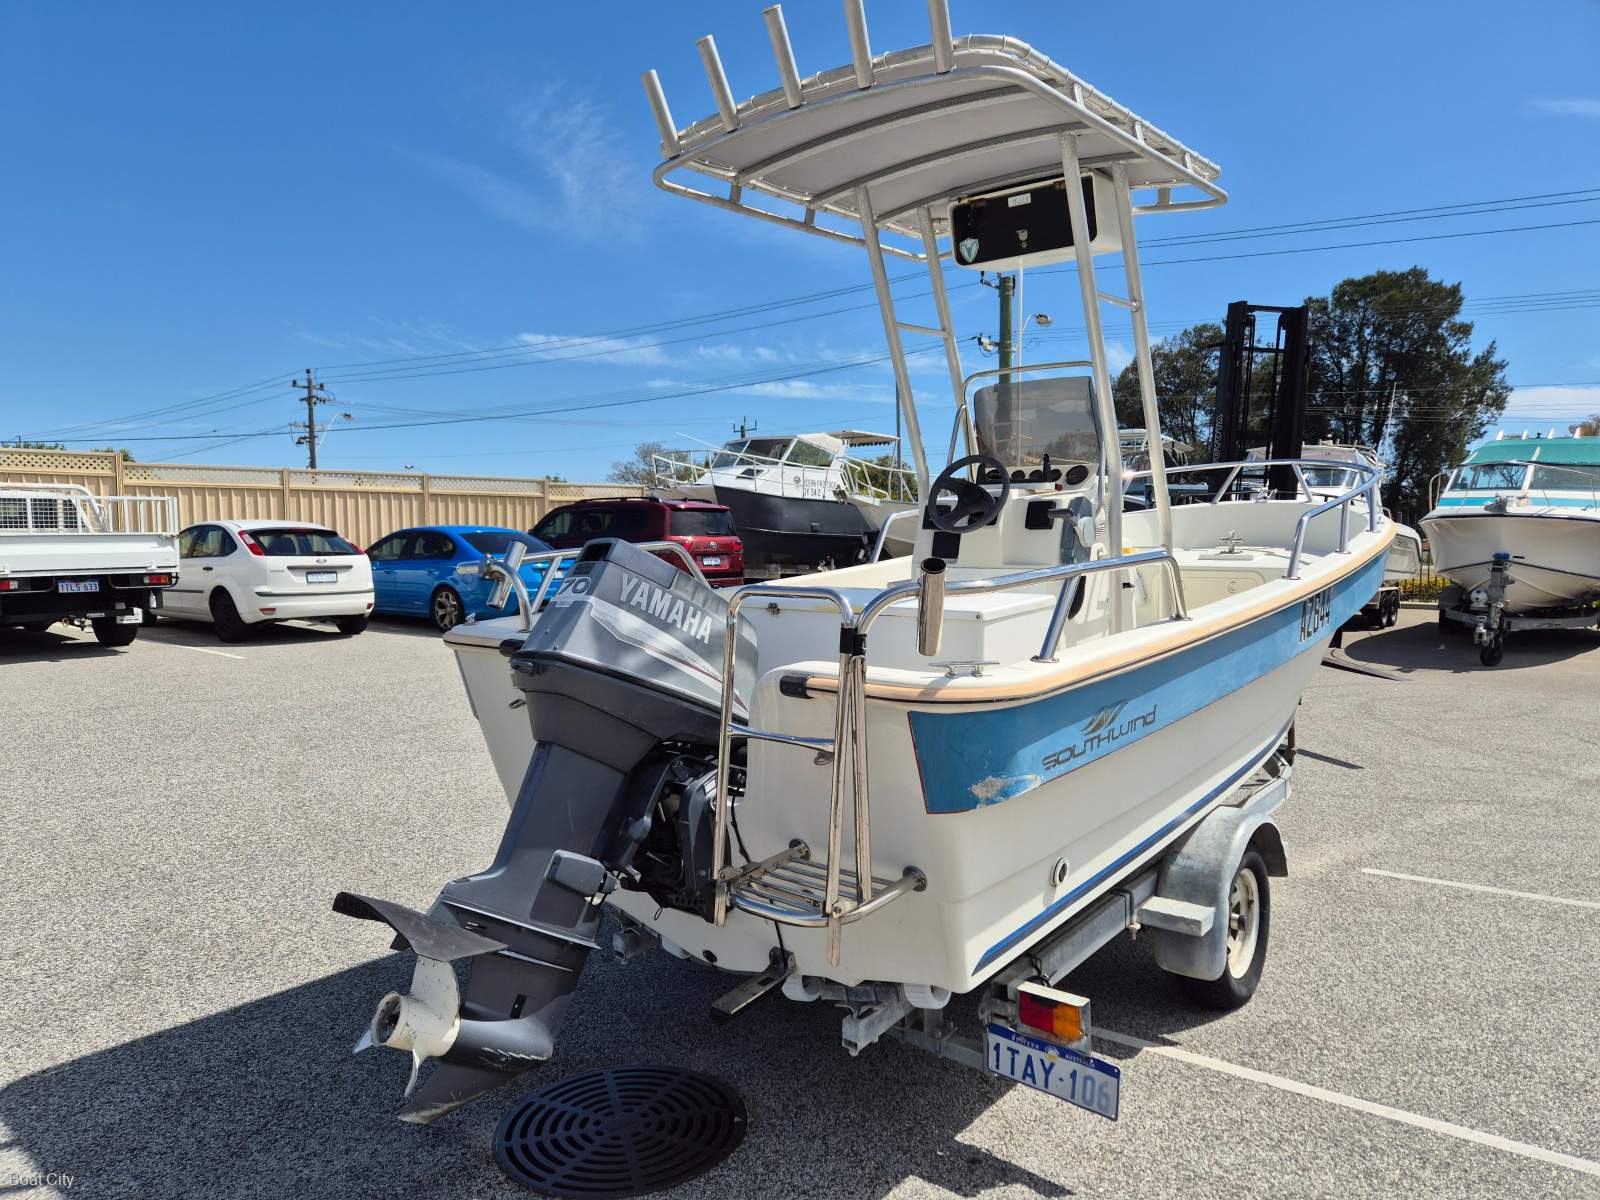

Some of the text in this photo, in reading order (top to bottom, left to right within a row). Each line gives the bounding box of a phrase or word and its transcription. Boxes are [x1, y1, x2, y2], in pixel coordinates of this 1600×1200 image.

[558, 577, 591, 595] 70
[620, 573, 713, 645] YAMAHA
[993, 1042, 1112, 1114] 1TAY-106
